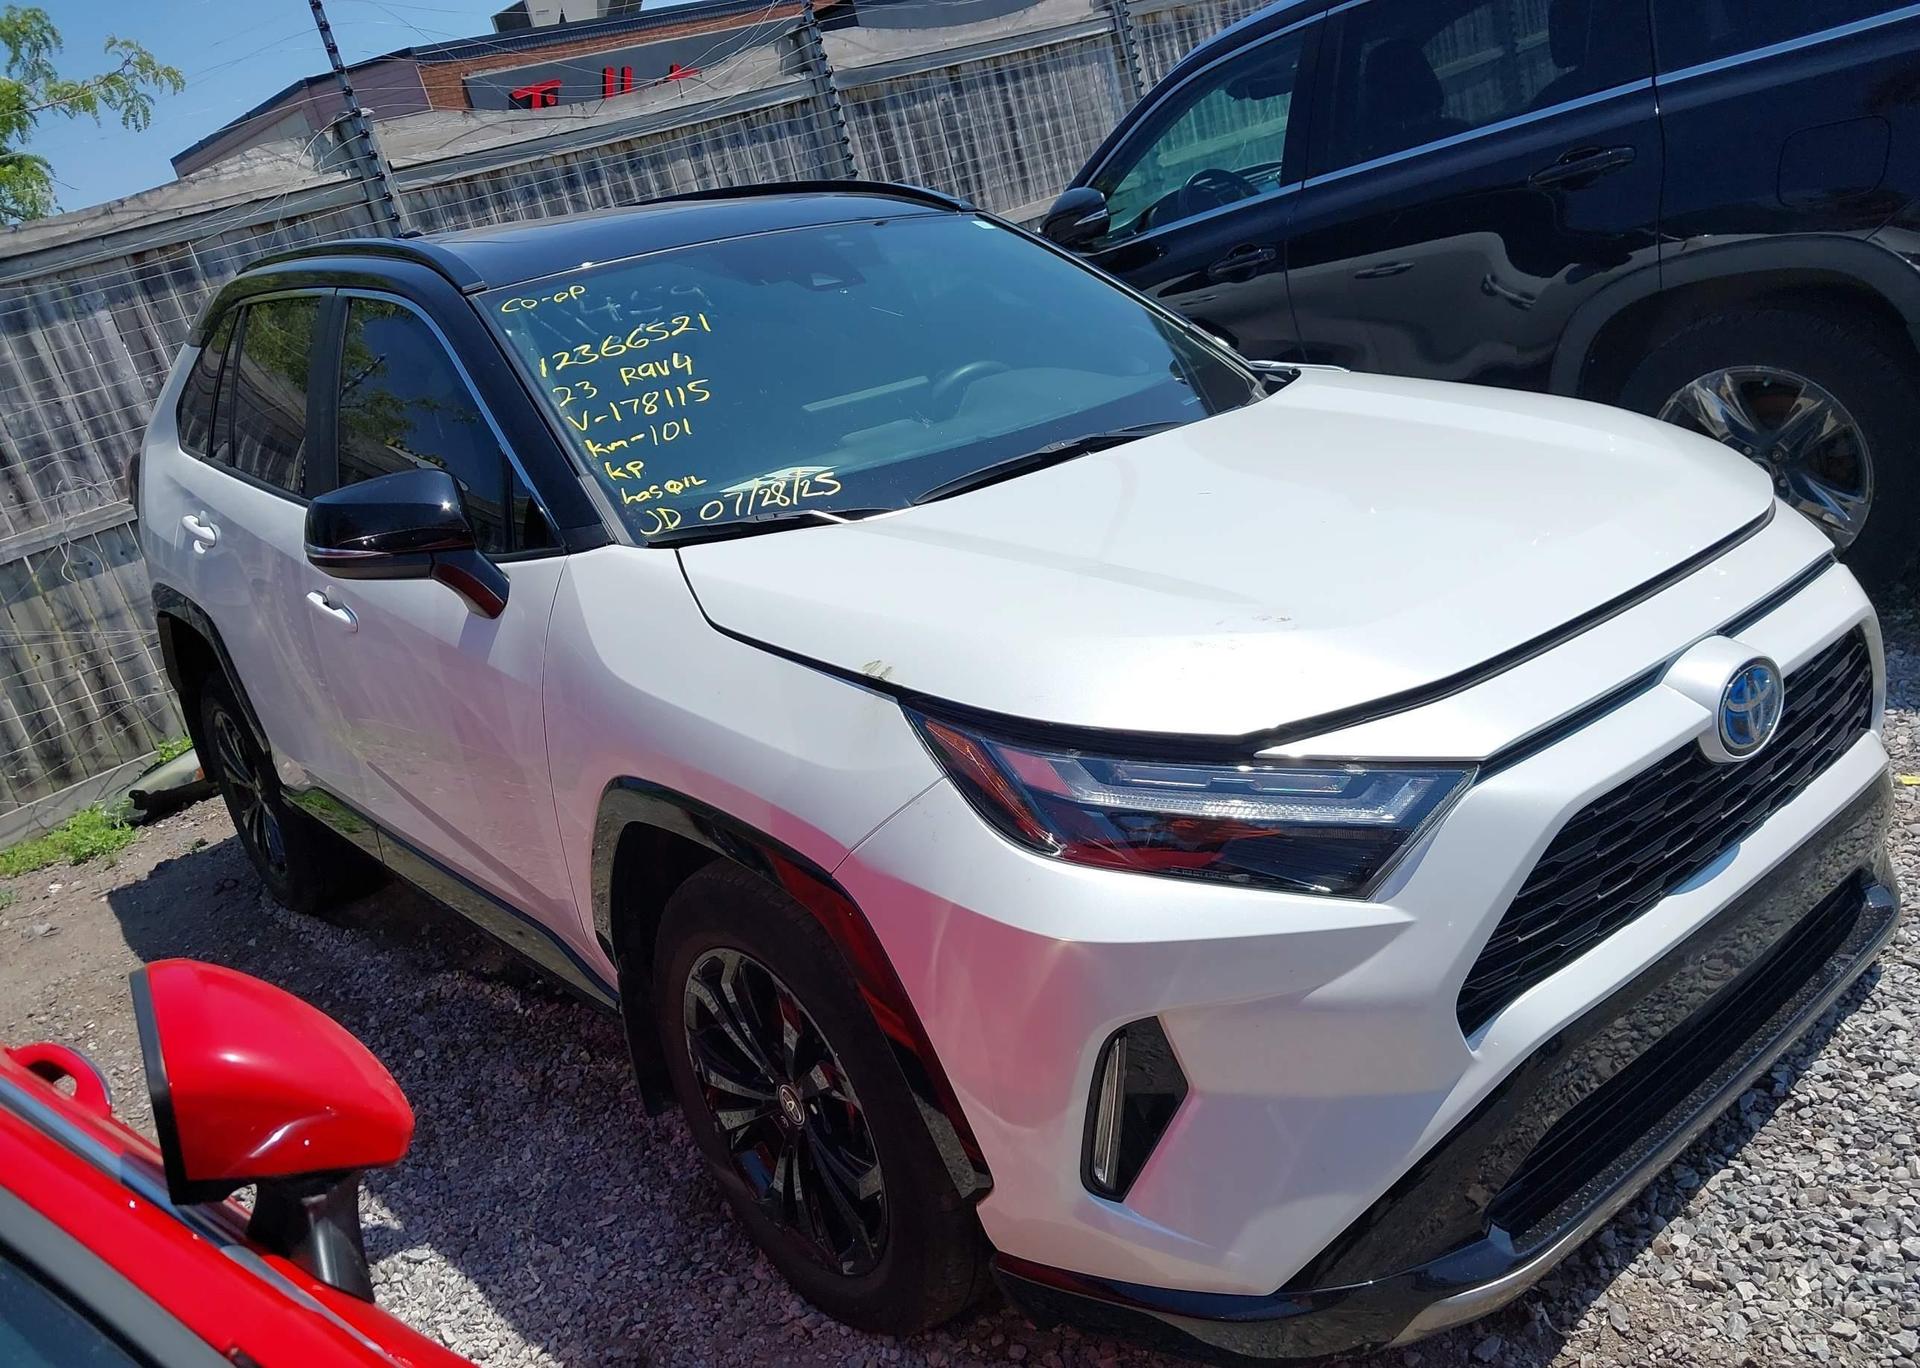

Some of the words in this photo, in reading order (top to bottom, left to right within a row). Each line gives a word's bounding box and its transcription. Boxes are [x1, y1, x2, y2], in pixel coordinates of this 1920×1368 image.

[539, 314, 712, 377] 12366521
[553, 380, 598, 407] 23
[699, 472, 842, 521] 07/28/25
